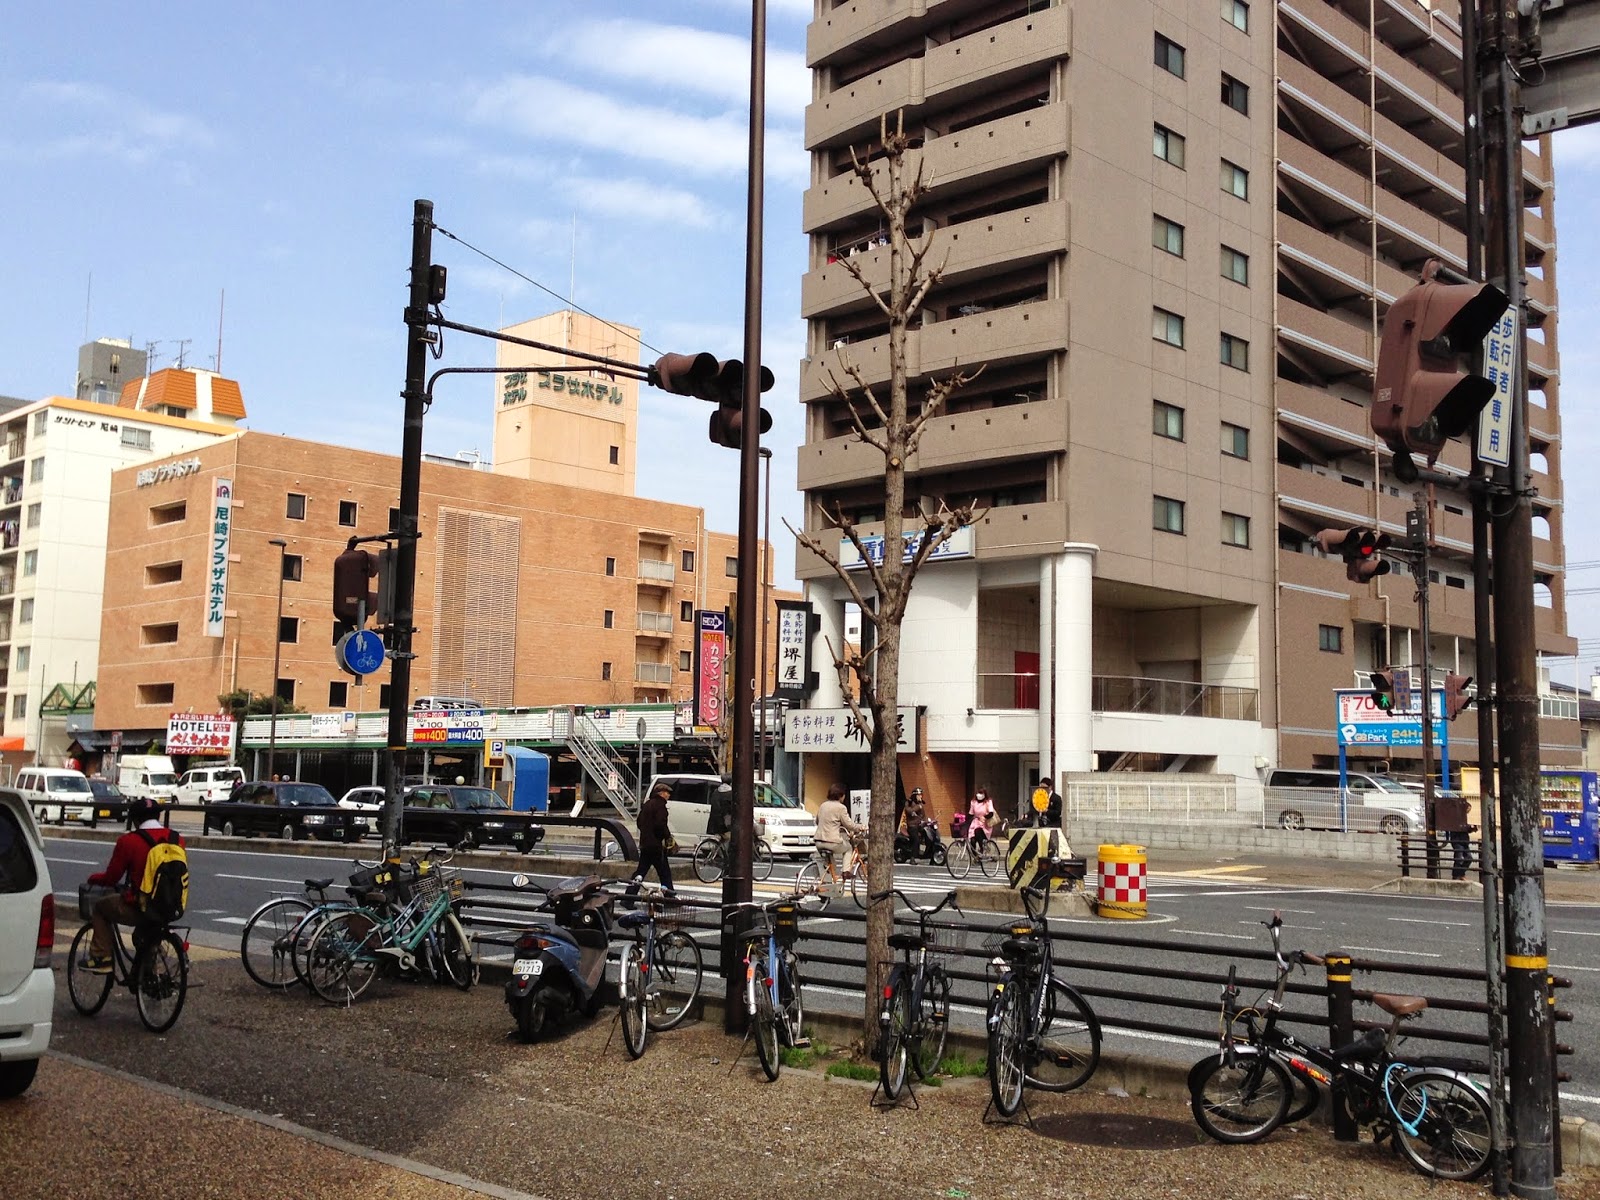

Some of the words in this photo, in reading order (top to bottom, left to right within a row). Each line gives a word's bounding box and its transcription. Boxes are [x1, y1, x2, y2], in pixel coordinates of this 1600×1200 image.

[1500, 316, 1513, 394] 歩行者
[503, 387, 527, 406] ホテル
[1488, 399, 1502, 453] 専用
[208, 506, 229, 623] 尼崎プラザホテル
[782, 612, 791, 644] 活魚料理
[794, 612, 803, 644] 季節料理
[703, 633, 722, 642] HOTEL
[783, 647, 802, 680] 堺屋
[344, 712, 354, 722] P
[792, 715, 835, 730] 季節料理
[170, 721, 212, 732] HOTEL
[1391, 729, 1417, 739] 24H
[493, 742, 502, 751] P
[792, 732, 835, 746] 活魚料理
